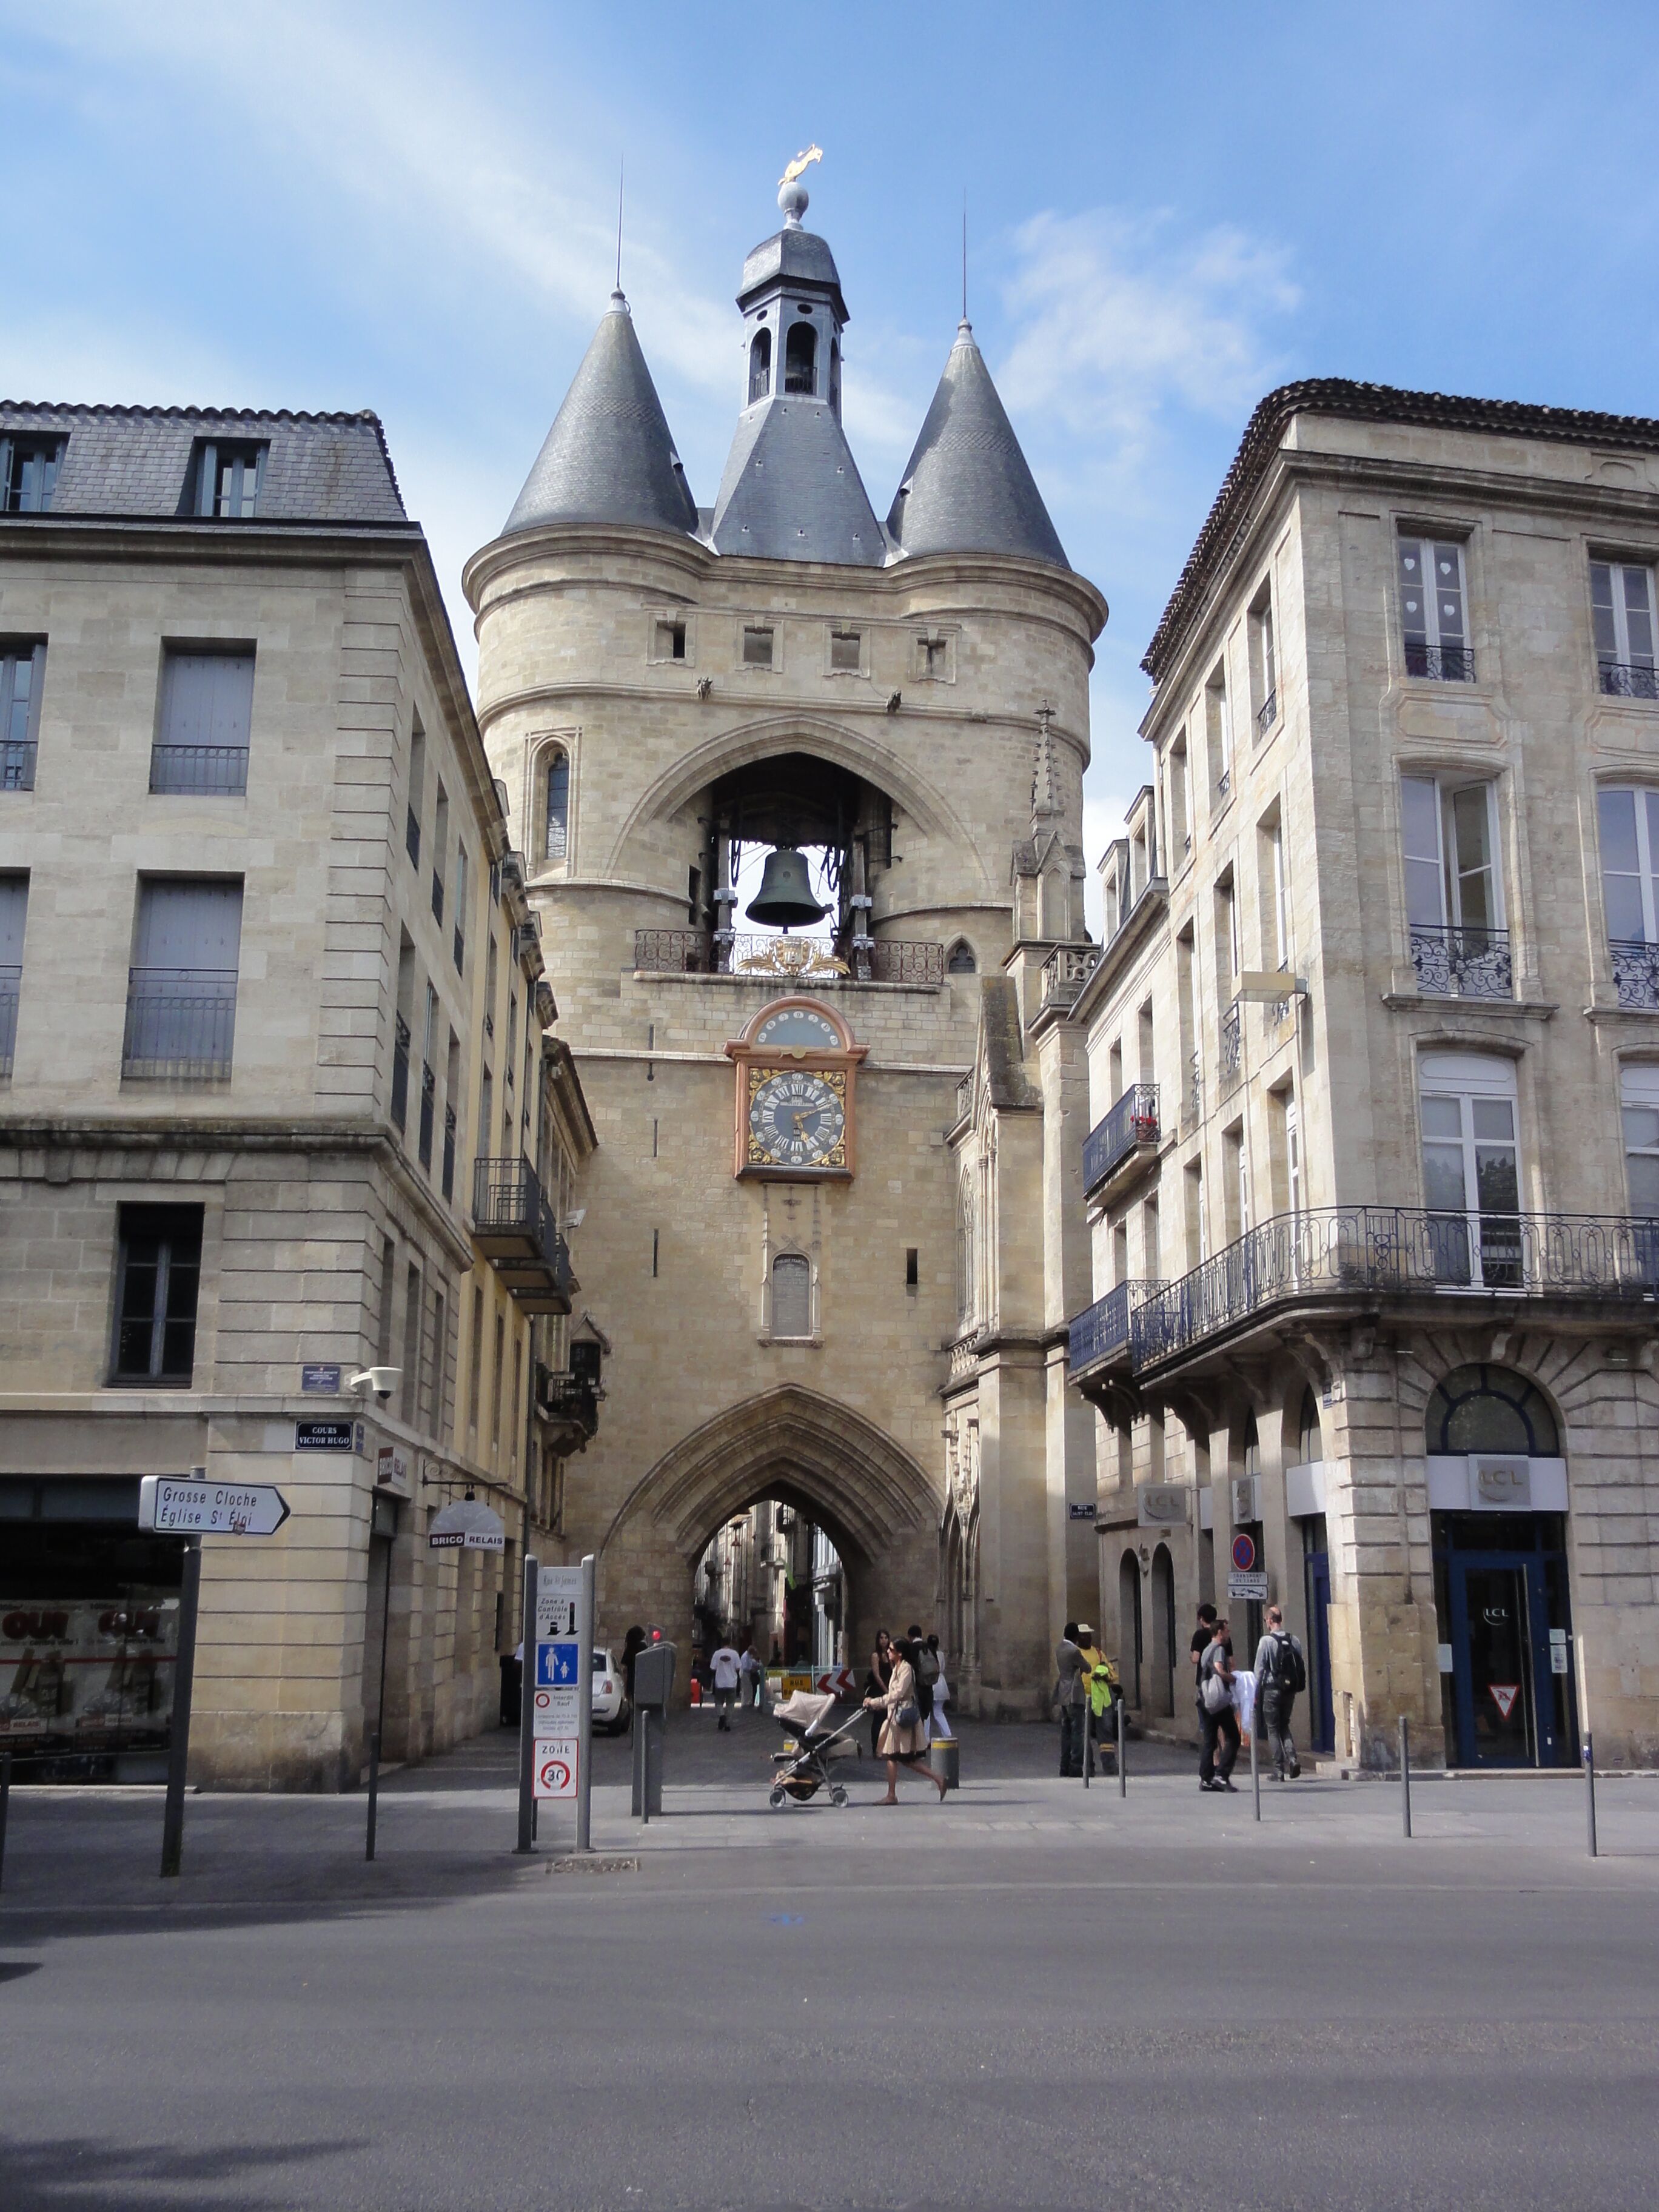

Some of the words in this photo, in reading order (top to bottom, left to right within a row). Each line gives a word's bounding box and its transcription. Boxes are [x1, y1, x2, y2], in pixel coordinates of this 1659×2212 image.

[1480, 1470, 1523, 1485] LCL
[163, 1487, 206, 1504] Grosse
[215, 1490, 257, 1507] Cloche
[1147, 1494, 1180, 1506] LCL
[161, 1504, 201, 1526] Église
[229, 1508, 252, 1526] Éloi
[432, 1536, 463, 1545] BRICO
[469, 1536, 503, 1544] RELAIS
[1486, 1608, 1509, 1617] LCL
[541, 1745, 570, 1754] ZONE
